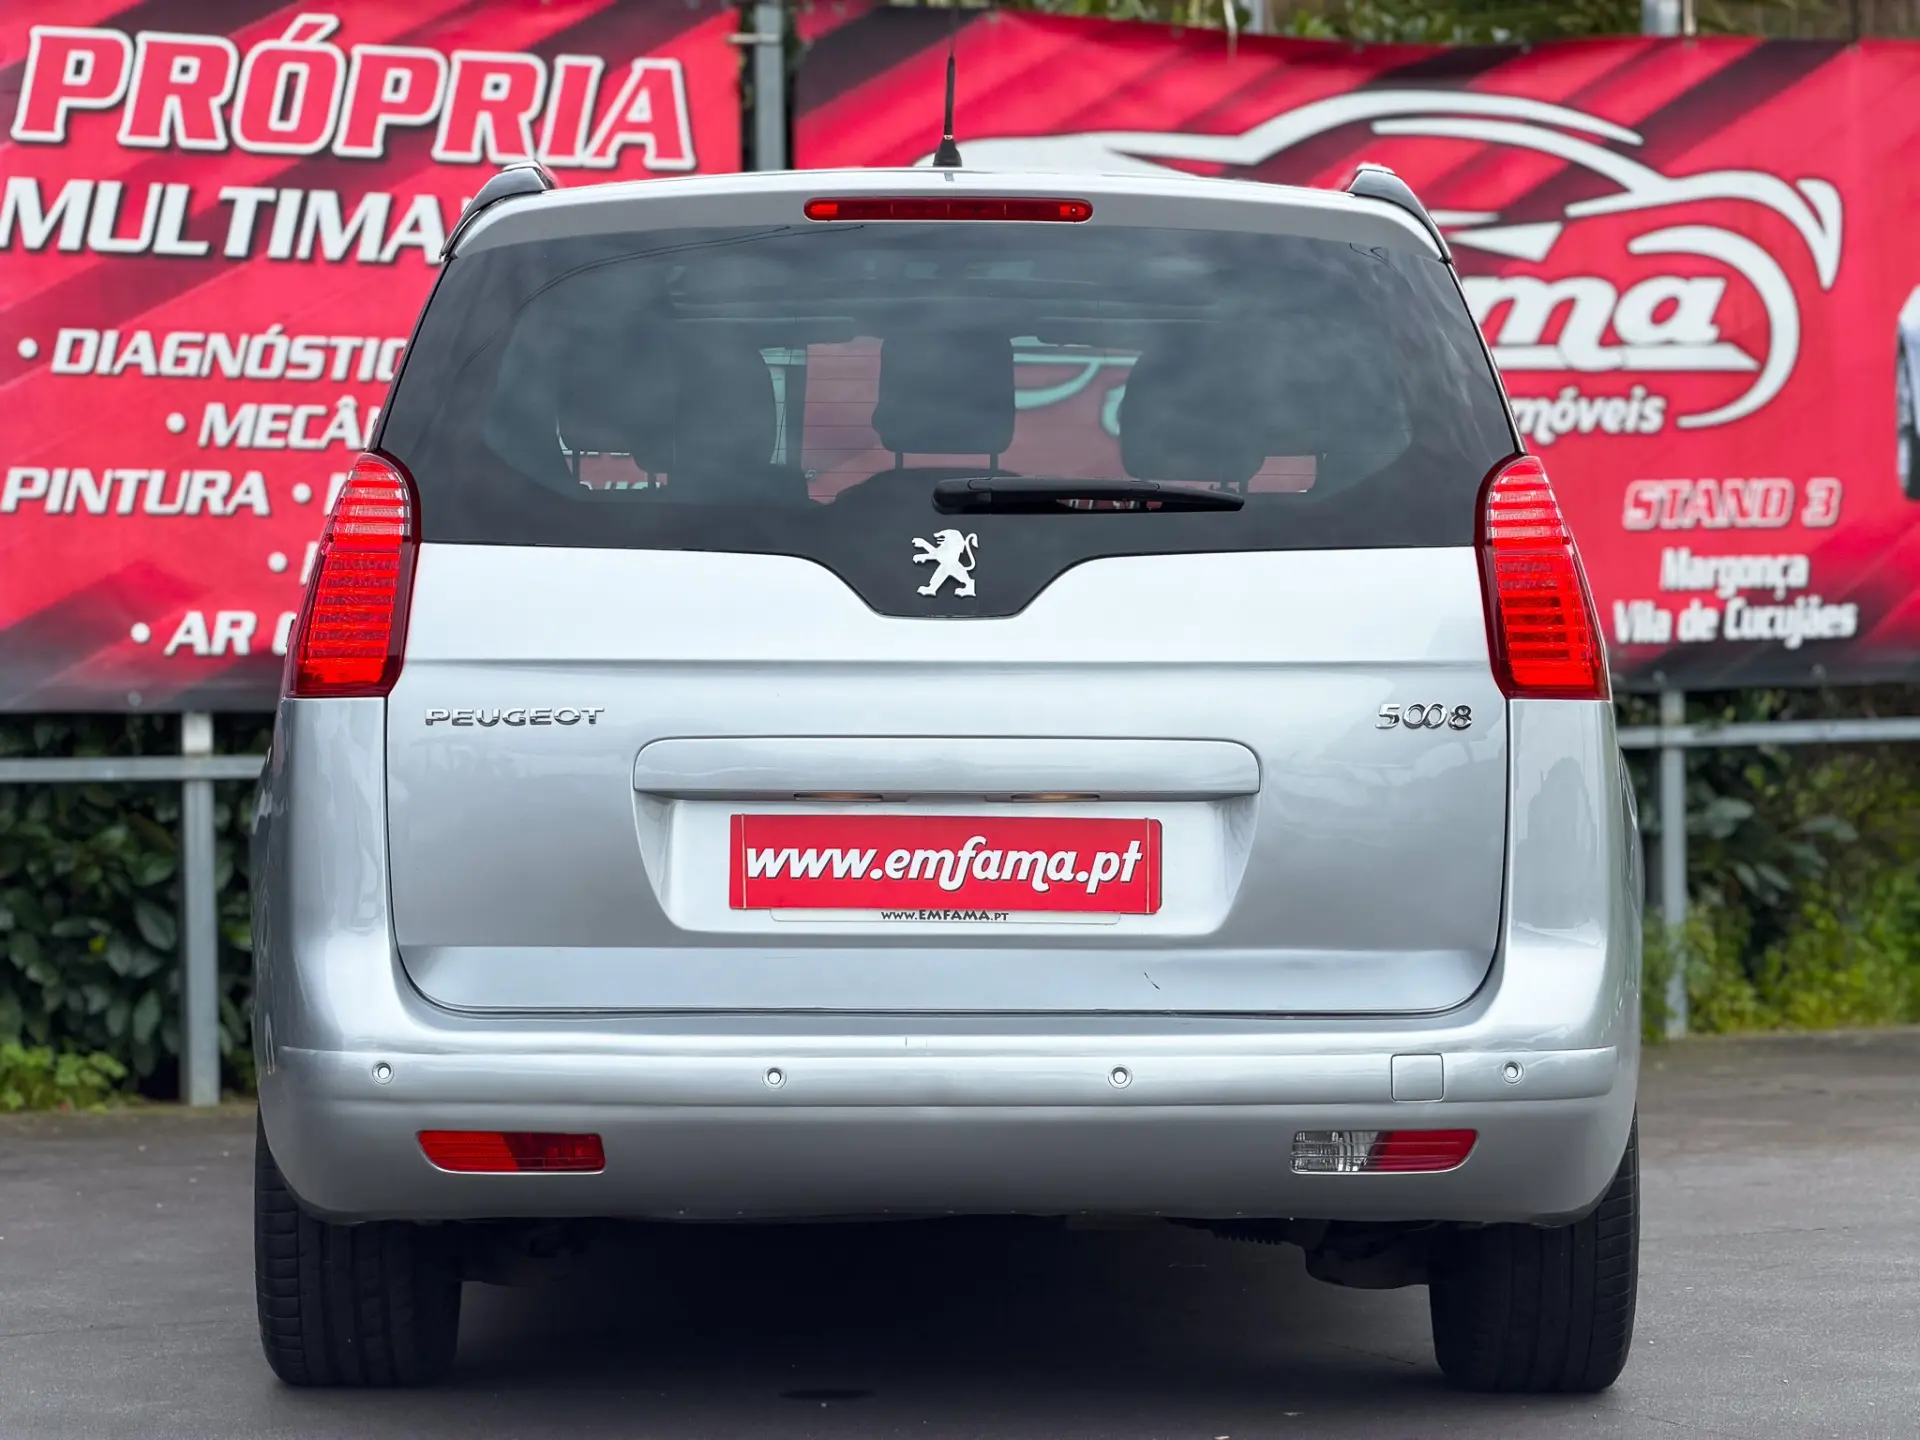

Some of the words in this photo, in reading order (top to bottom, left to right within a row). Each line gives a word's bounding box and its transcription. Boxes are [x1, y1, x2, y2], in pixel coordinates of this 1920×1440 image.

[11, 13, 697, 171] PRÓPRIA
[0, 175, 474, 265] MULTIMA
[0, 466, 271, 516] PINTURA
[1621, 478, 1795, 531] STAND
[1801, 477, 1842, 528] 3
[163, 610, 257, 656] AR
[1612, 599, 1673, 645] Vila
[1677, 598, 1720, 643] de
[425, 706, 605, 727] PEUGEOT
[1375, 703, 1473, 731] 5008
[745, 835, 1143, 894] www.emfama.pt
